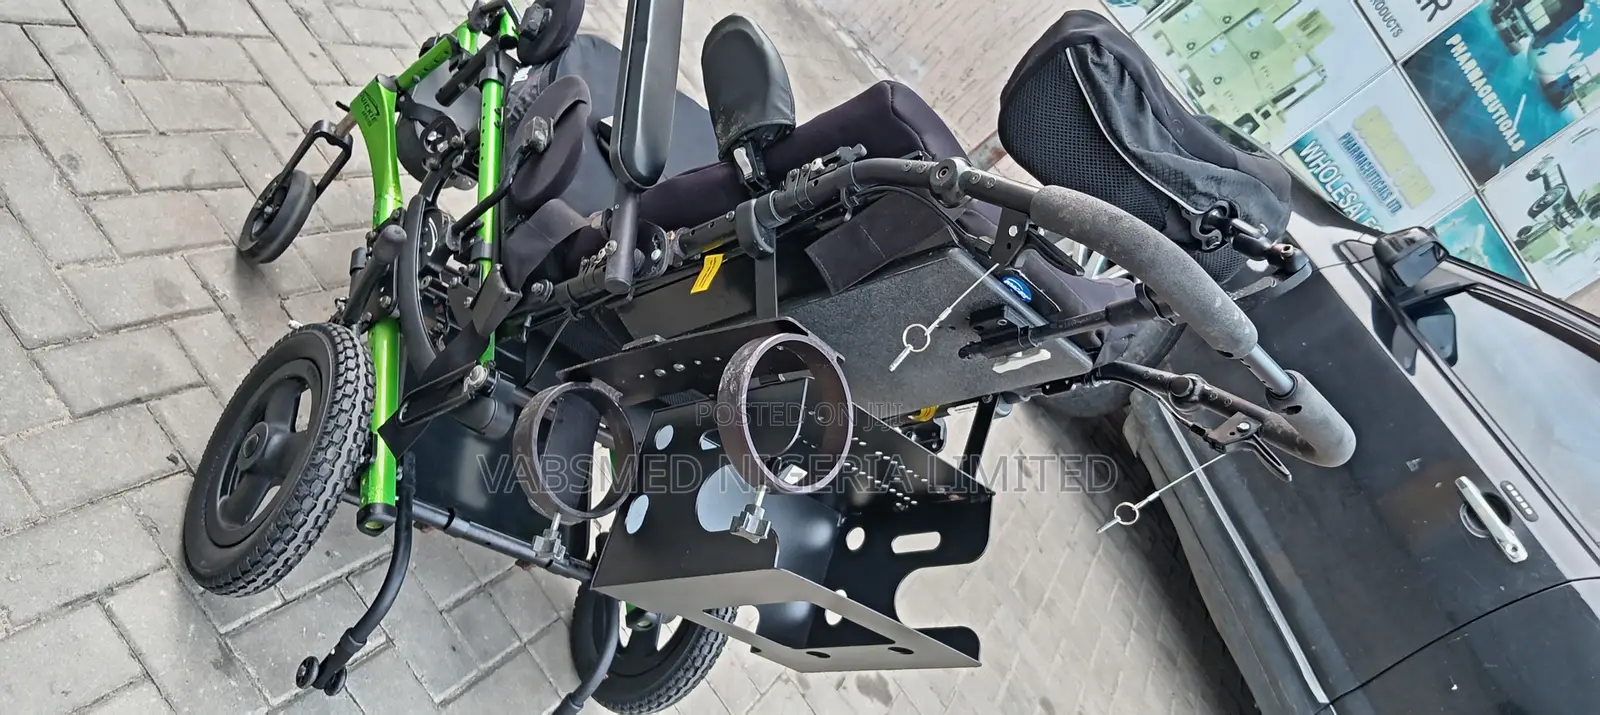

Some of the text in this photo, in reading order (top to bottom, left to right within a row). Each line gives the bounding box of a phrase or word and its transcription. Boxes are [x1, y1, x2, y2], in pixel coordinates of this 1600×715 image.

[1445, 33, 1525, 152] PHARMACEUTICALS
[1299, 138, 1384, 232] WHOLESALE
[1338, 131, 1393, 202] PHARMACEUTICALS
